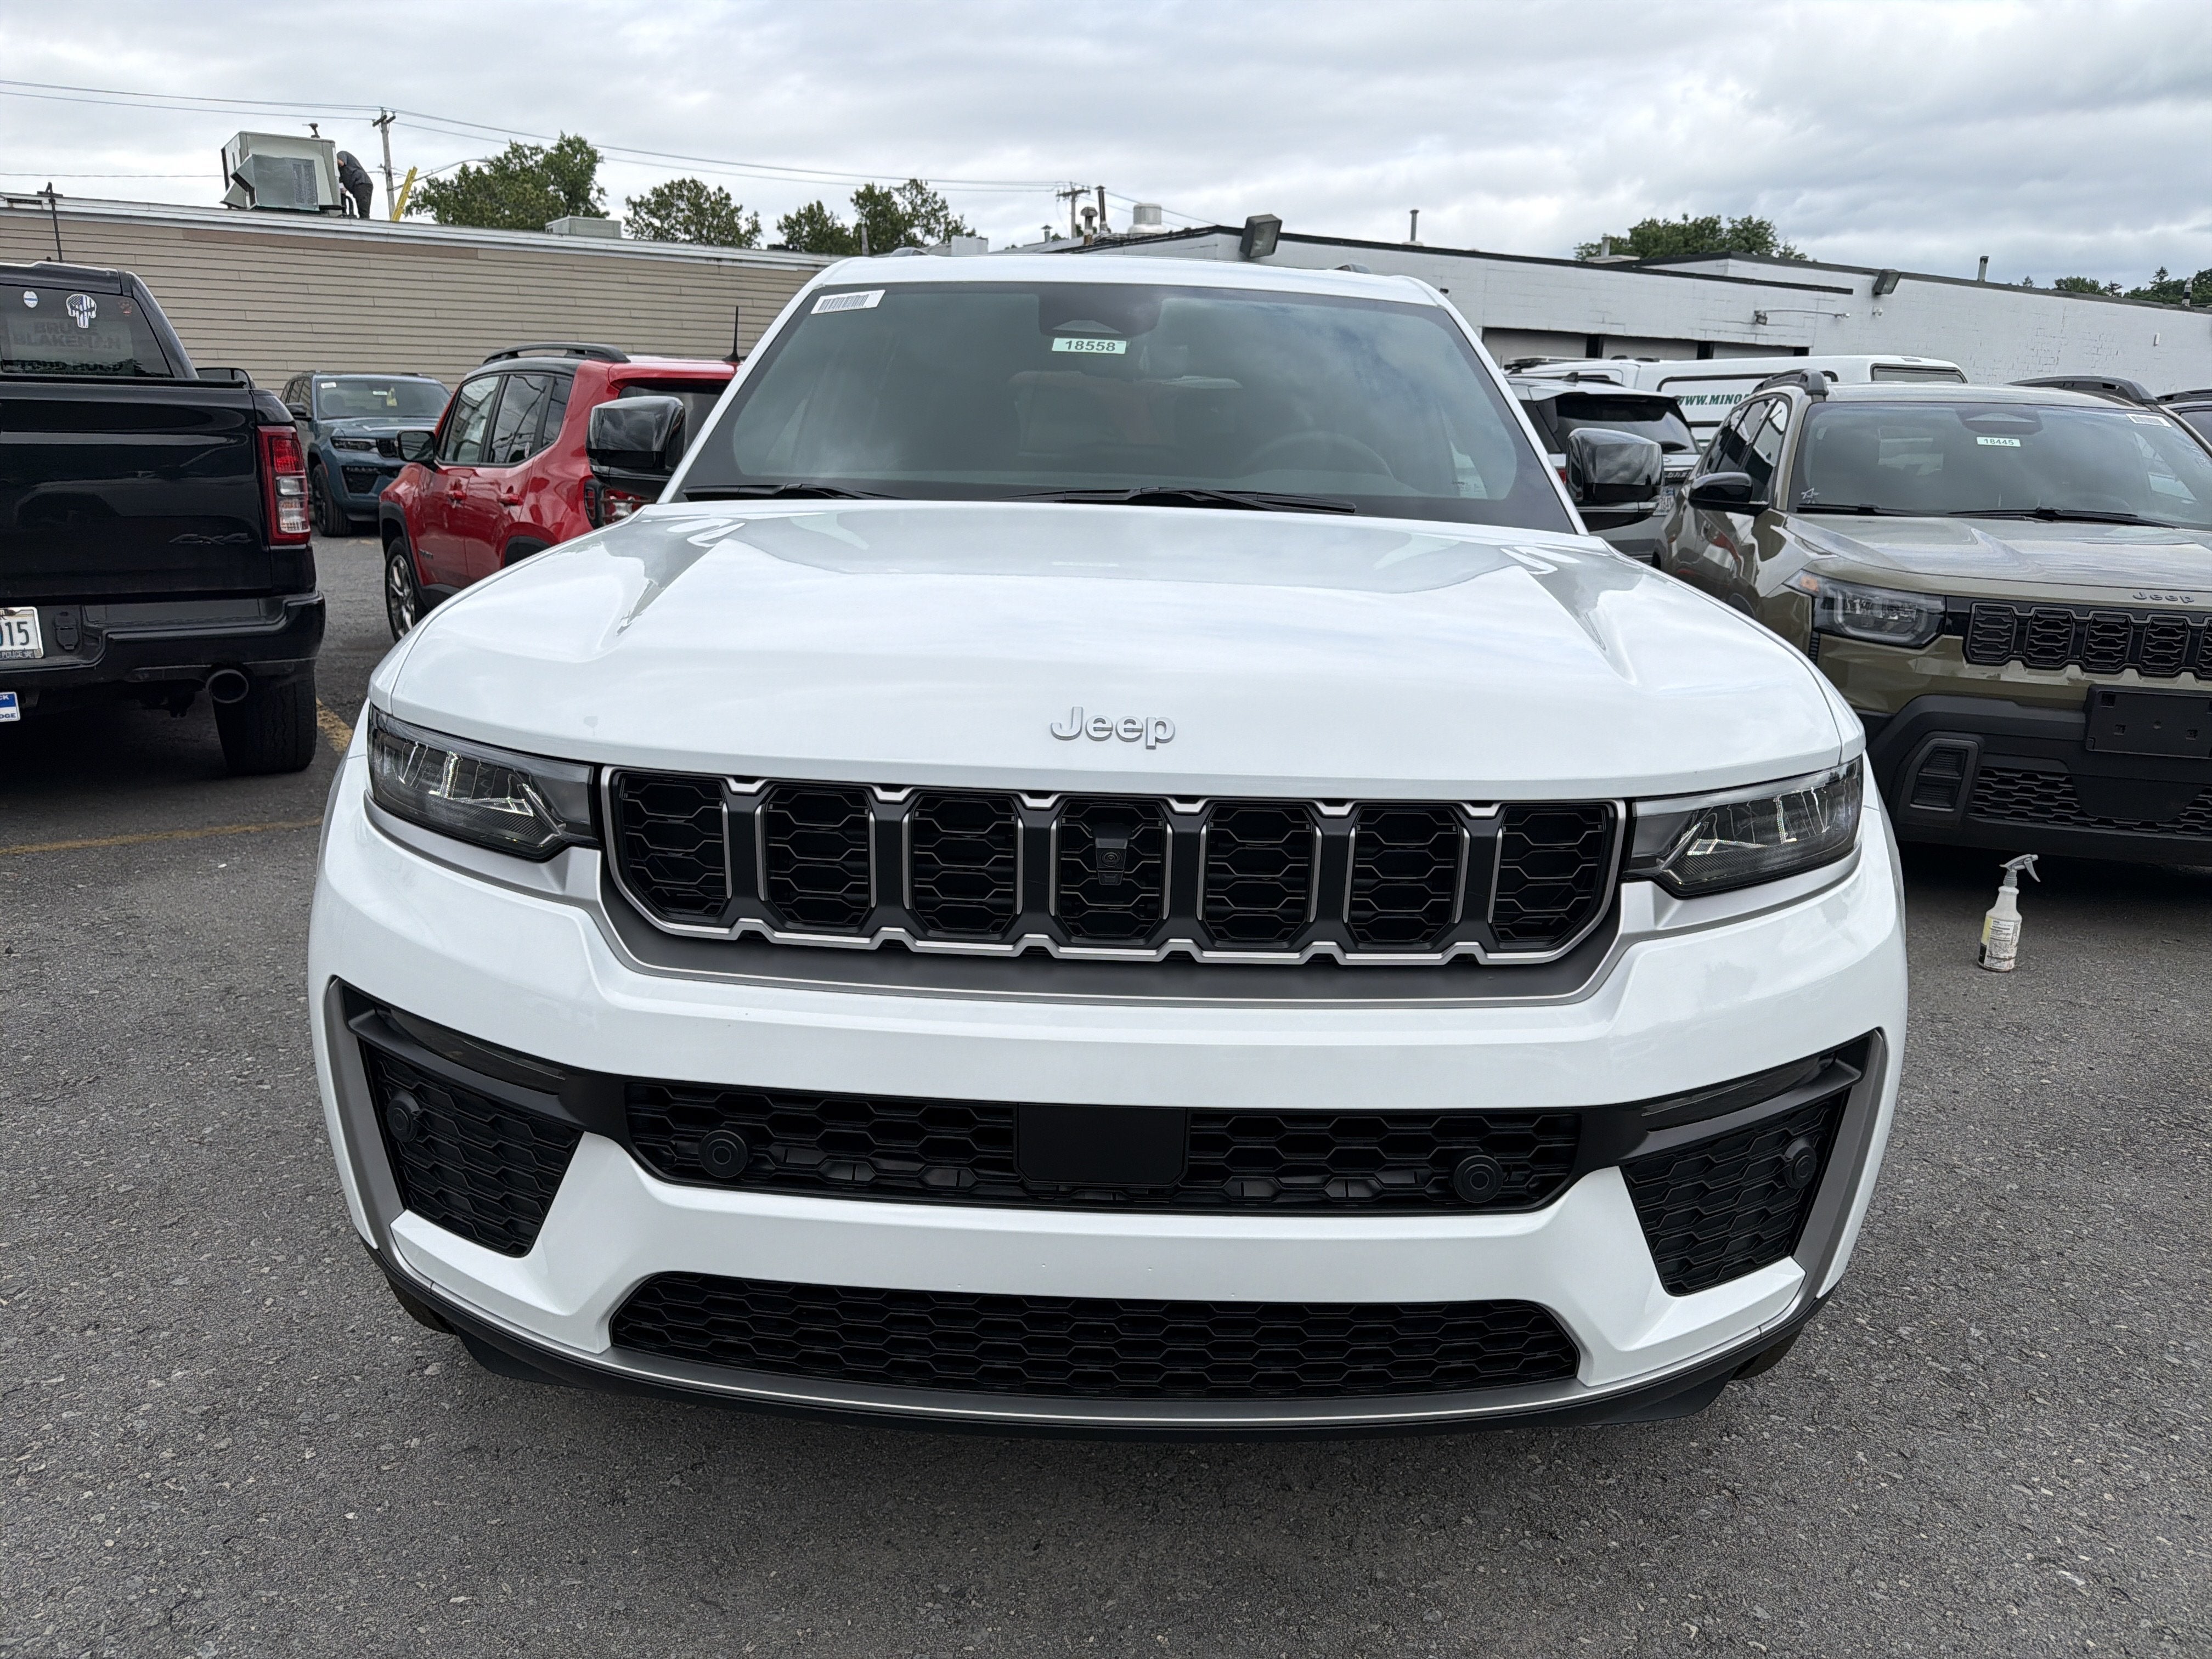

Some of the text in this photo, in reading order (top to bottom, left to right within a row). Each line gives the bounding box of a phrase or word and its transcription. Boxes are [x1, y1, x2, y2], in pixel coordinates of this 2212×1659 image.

[1065, 340, 1115, 352] 18558
[2132, 591, 2194, 603] Jeep
[1051, 706, 1176, 749] Jeep
